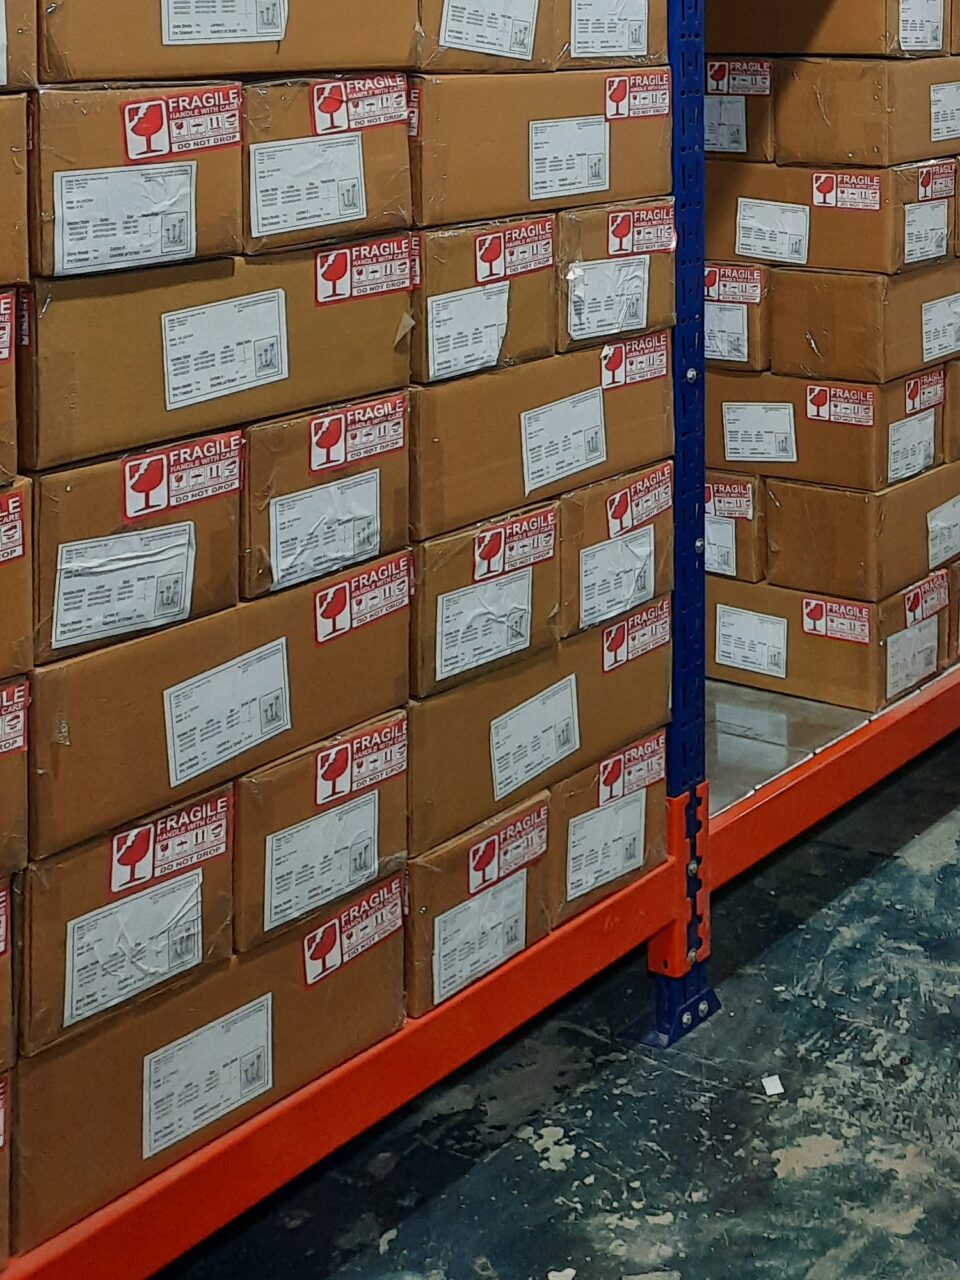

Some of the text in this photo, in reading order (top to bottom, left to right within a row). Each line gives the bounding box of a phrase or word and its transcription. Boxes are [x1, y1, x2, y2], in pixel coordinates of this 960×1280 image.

[730, 62, 770, 71] FRAGILE
[346, 75, 405, 95] FRAGILE
[630, 74, 669, 86] FRAGILE
[168, 89, 238, 113] FRAGILE
[169, 103, 238, 120] HANDLE WITH CARE
[354, 113, 403, 129] DO NOT DROP
[177, 134, 236, 150] DO NOT DROP
[838, 175, 879, 185] FRAGILE
[634, 208, 674, 221] FRAGILE
[505, 222, 552, 243] FRAGILE
[352, 241, 410, 261] FRAGILE
[352, 253, 409, 267] HANDLE WITH CARE
[720, 269, 760, 279] FRAGILE
[370, 284, 383, 292] NOT
[387, 280, 406, 289] DROP
[626, 335, 667, 353] FRAGILE
[831, 388, 874, 401] FRAGILE
[347, 401, 404, 422] FRAGILE
[170, 437, 240, 467] FRAGILE
[170, 451, 239, 474] HANDLE WITH CARE
[176, 482, 235, 504] DO NOT DROP
[631, 468, 671, 497] FRAGILE
[506, 513, 554, 538] FRAGILE
[351, 559, 408, 593] FRAGILE
[629, 603, 669, 629] FRAGILE
[827, 602, 869, 618] FRAGILE
[353, 721, 407, 754] FRAGILE
[624, 737, 665, 764] FRAGILE
[156, 798, 227, 836] FRAGILE
[156, 812, 226, 843] HANDLE WITH CARE
[500, 807, 547, 845] FRAGILE
[160, 845, 221, 873] DO NOT DROP
[341, 880, 401, 927] FRAGILE
